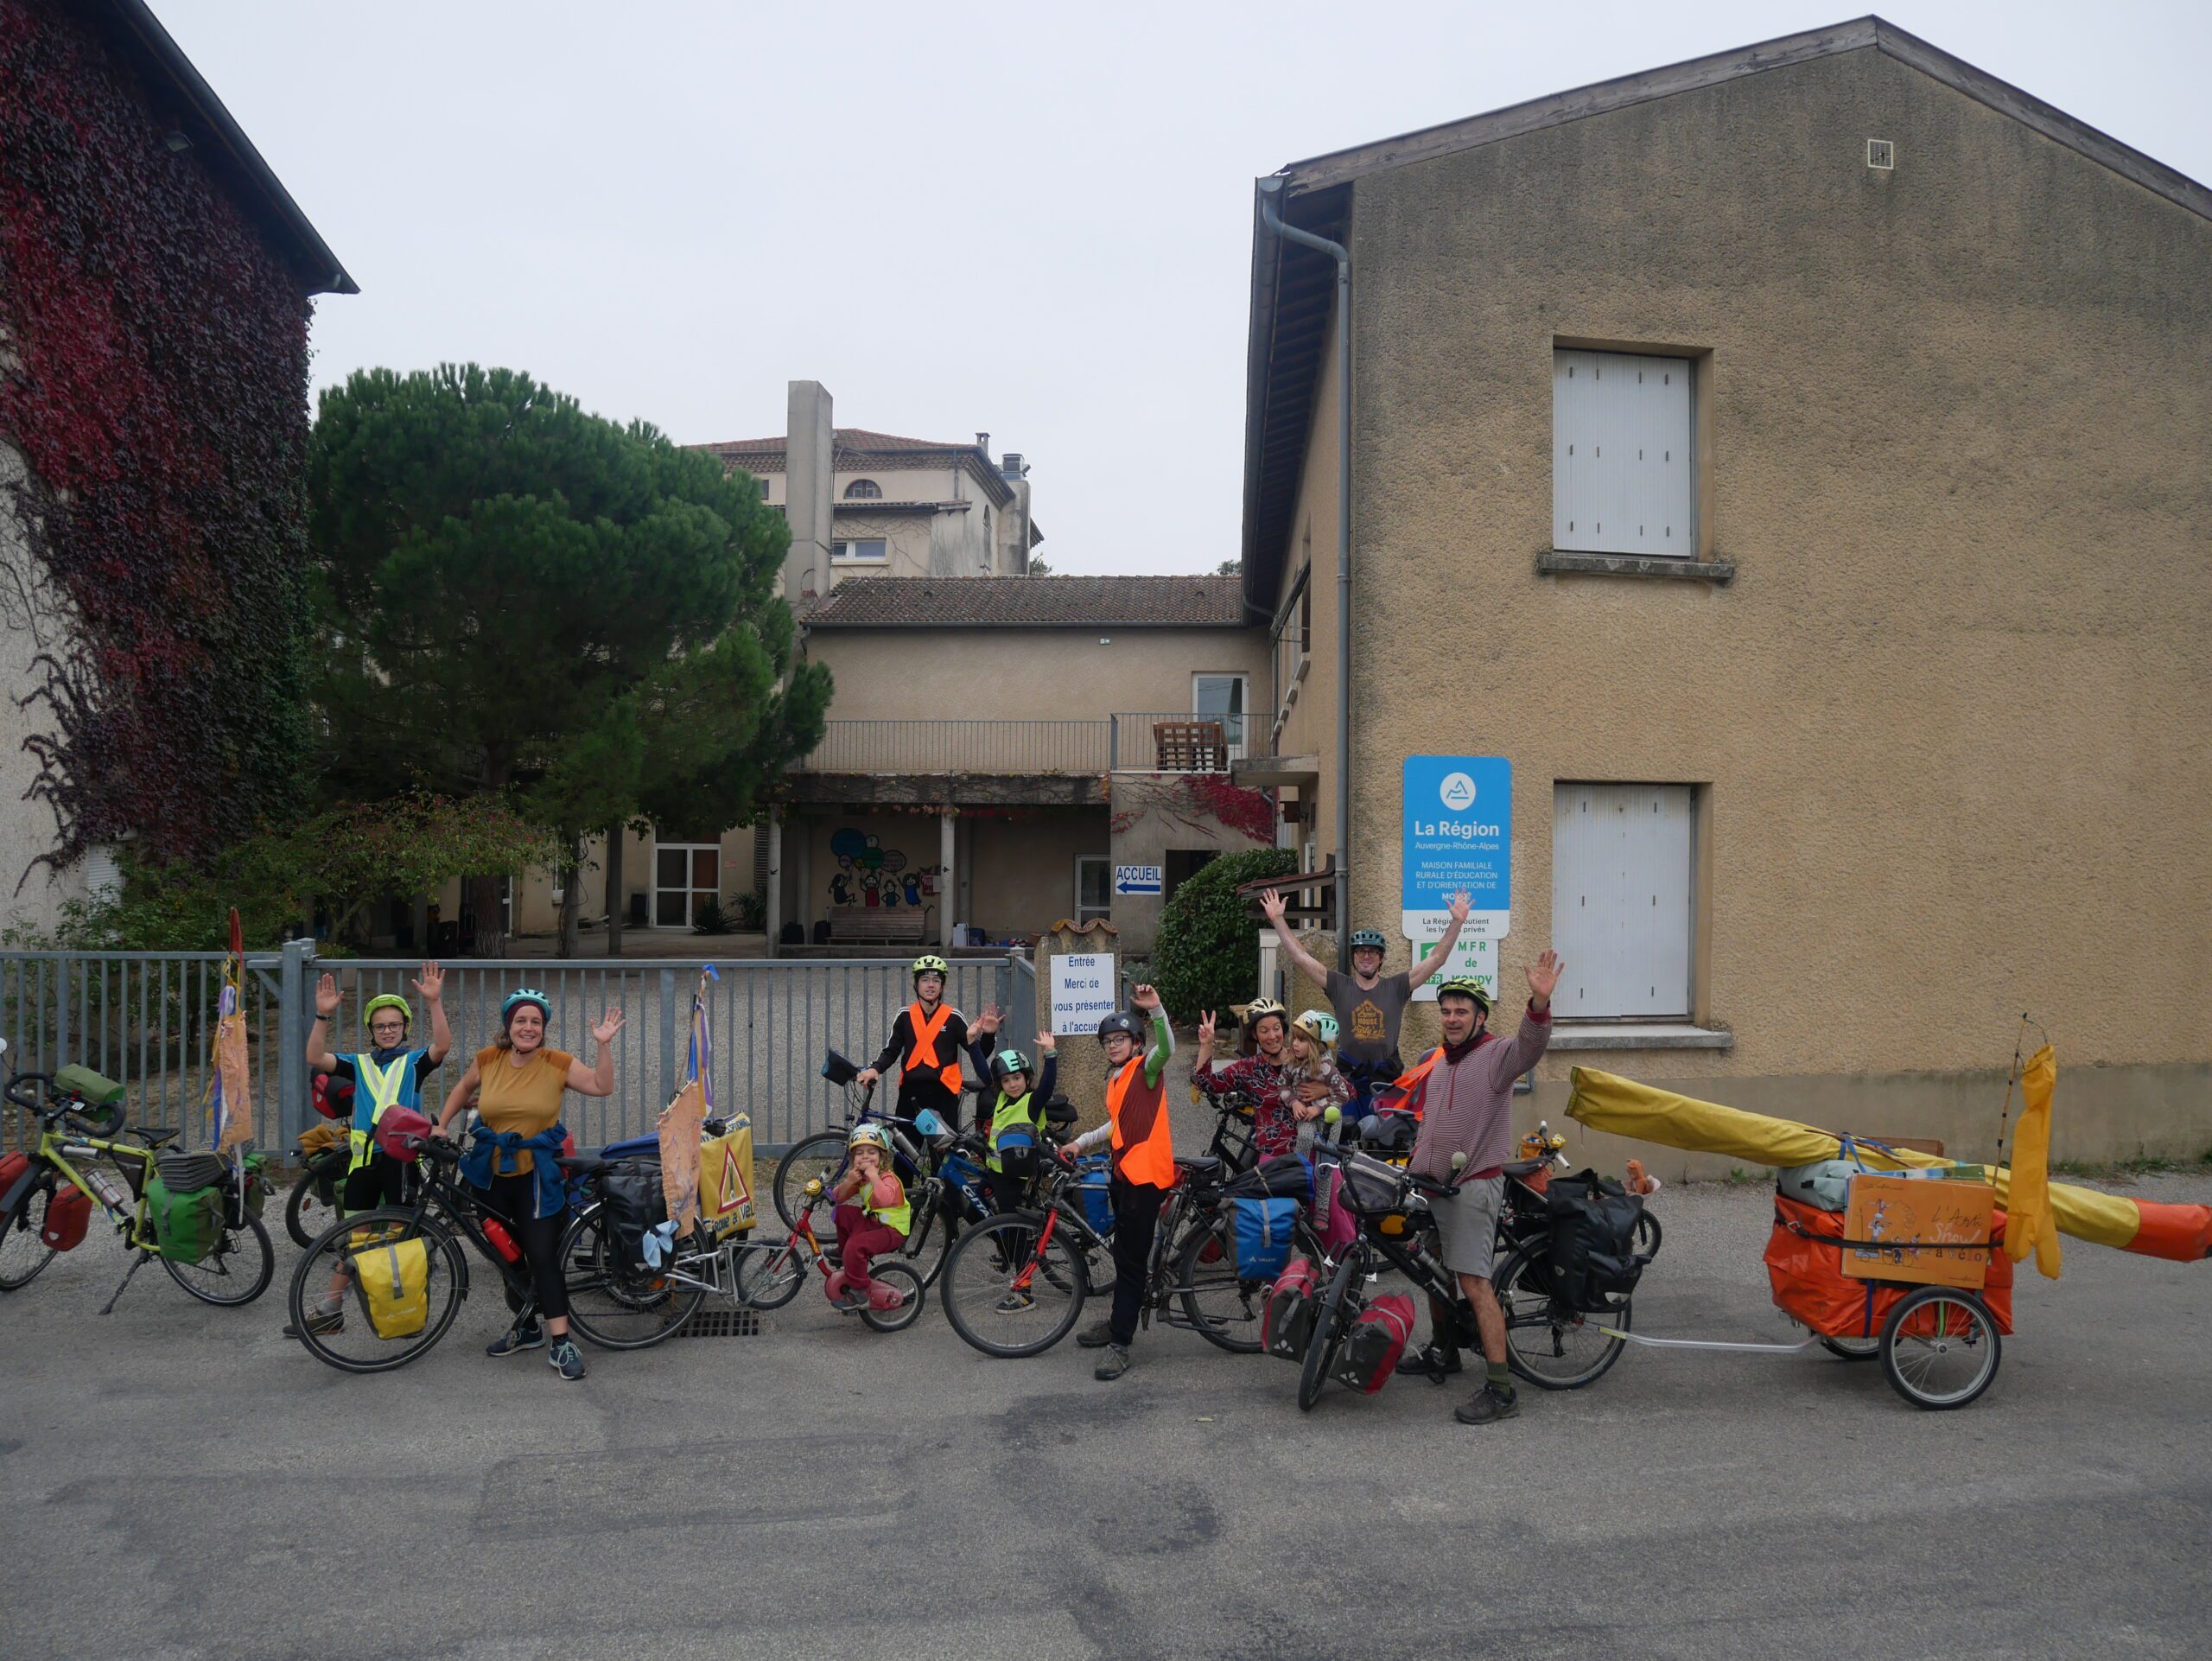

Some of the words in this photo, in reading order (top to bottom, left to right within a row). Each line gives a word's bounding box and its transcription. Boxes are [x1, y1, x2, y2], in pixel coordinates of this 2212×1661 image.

[1414, 820, 1434, 836] La
[1439, 820, 1499, 840] Région
[1414, 842, 1500, 851] Auvergne-Rhône-Alpes
[1116, 867, 1160, 881] ACCUEIL
[1446, 870, 1498, 879] D'ÉDUCATION
[1068, 956, 1096, 967] Entrée
[1465, 957, 1478, 967] de
[1065, 978, 1087, 990] Merci
[1089, 977, 1100, 989] de
[1053, 1001, 1073, 1011] vous
[1075, 1000, 1115, 1014] présenter
[1062, 1022, 1067, 1033] à
[1069, 1021, 1101, 1033] l'accuei
[962, 1184, 990, 1218] GITA
[1929, 1222, 1981, 1244] Show
